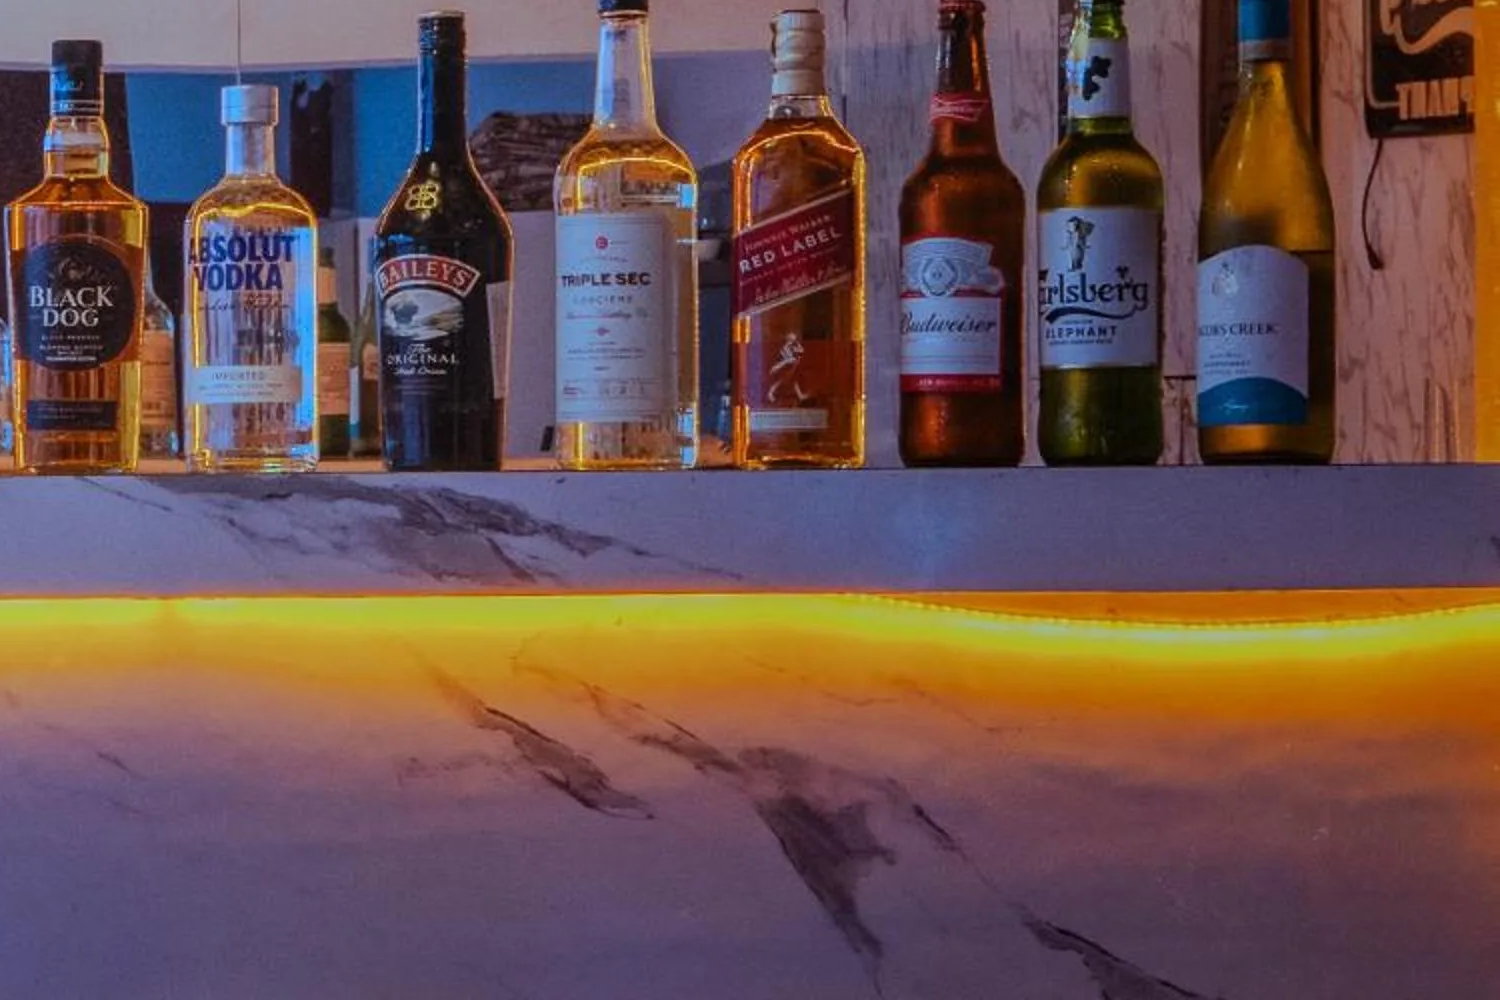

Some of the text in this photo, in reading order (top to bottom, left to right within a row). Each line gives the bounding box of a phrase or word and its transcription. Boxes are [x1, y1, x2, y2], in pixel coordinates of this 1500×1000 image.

[739, 250, 776, 274] RED
[781, 226, 843, 257] LABEL
[193, 263, 282, 292] VODKA
[561, 271, 651, 287] TRIPLE SEC
[29, 284, 113, 308] BLACK
[43, 306, 99, 328] DOG
